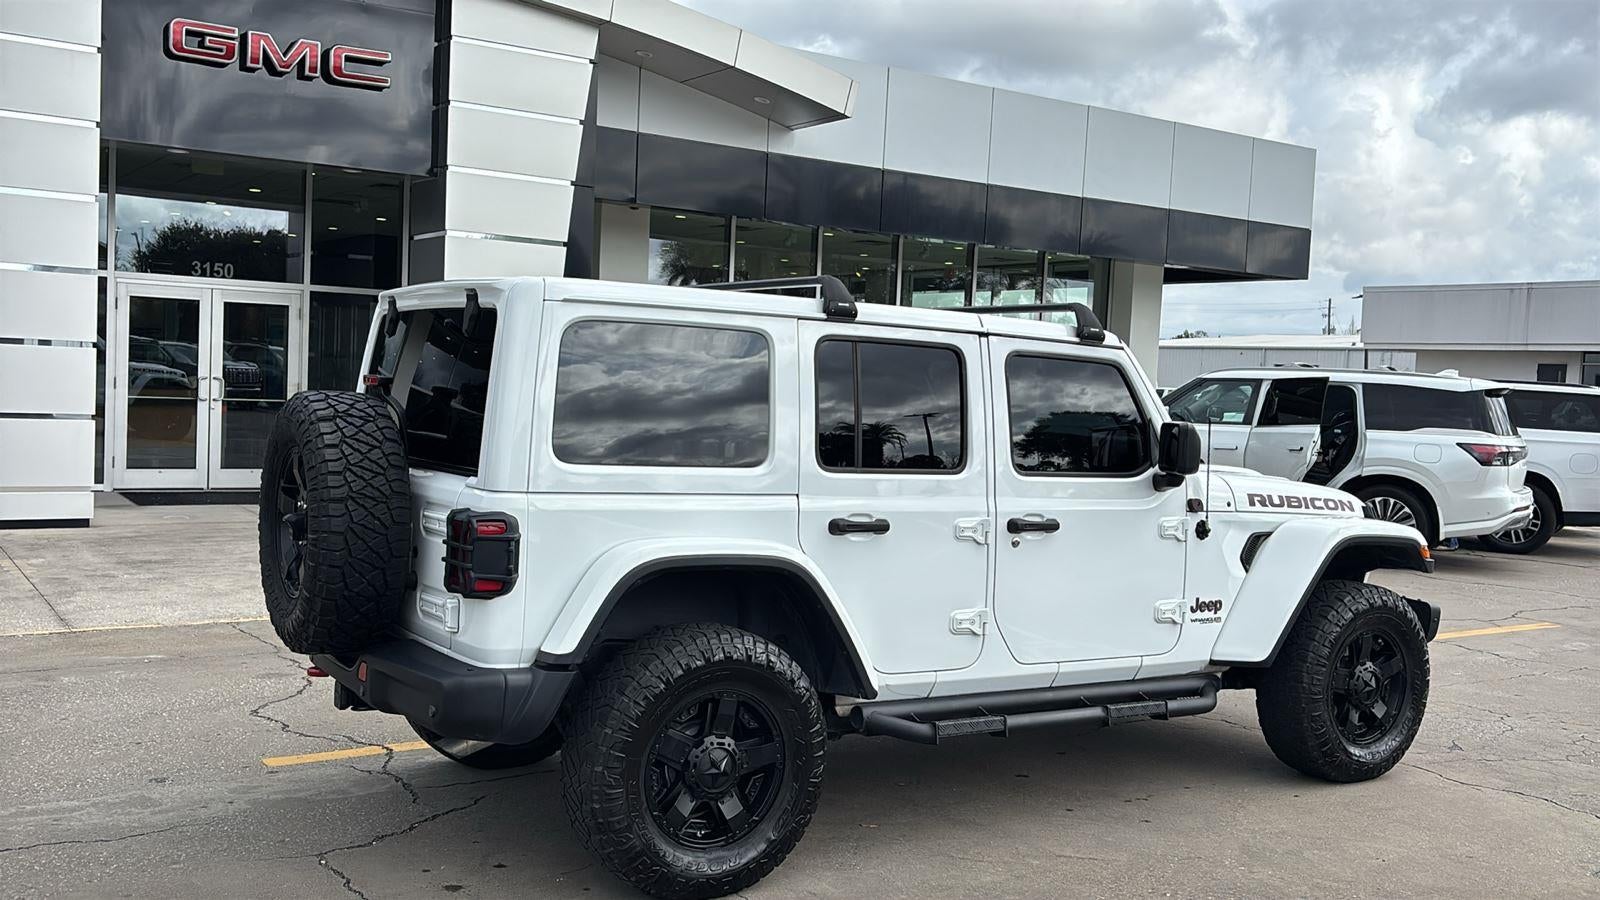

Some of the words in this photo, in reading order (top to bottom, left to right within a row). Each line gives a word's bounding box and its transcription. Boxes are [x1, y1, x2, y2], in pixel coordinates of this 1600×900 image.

[163, 17, 392, 92] GMC
[191, 260, 234, 279] 3150
[1246, 492, 1356, 513] RUBICON
[1190, 597, 1223, 615] Jeep
